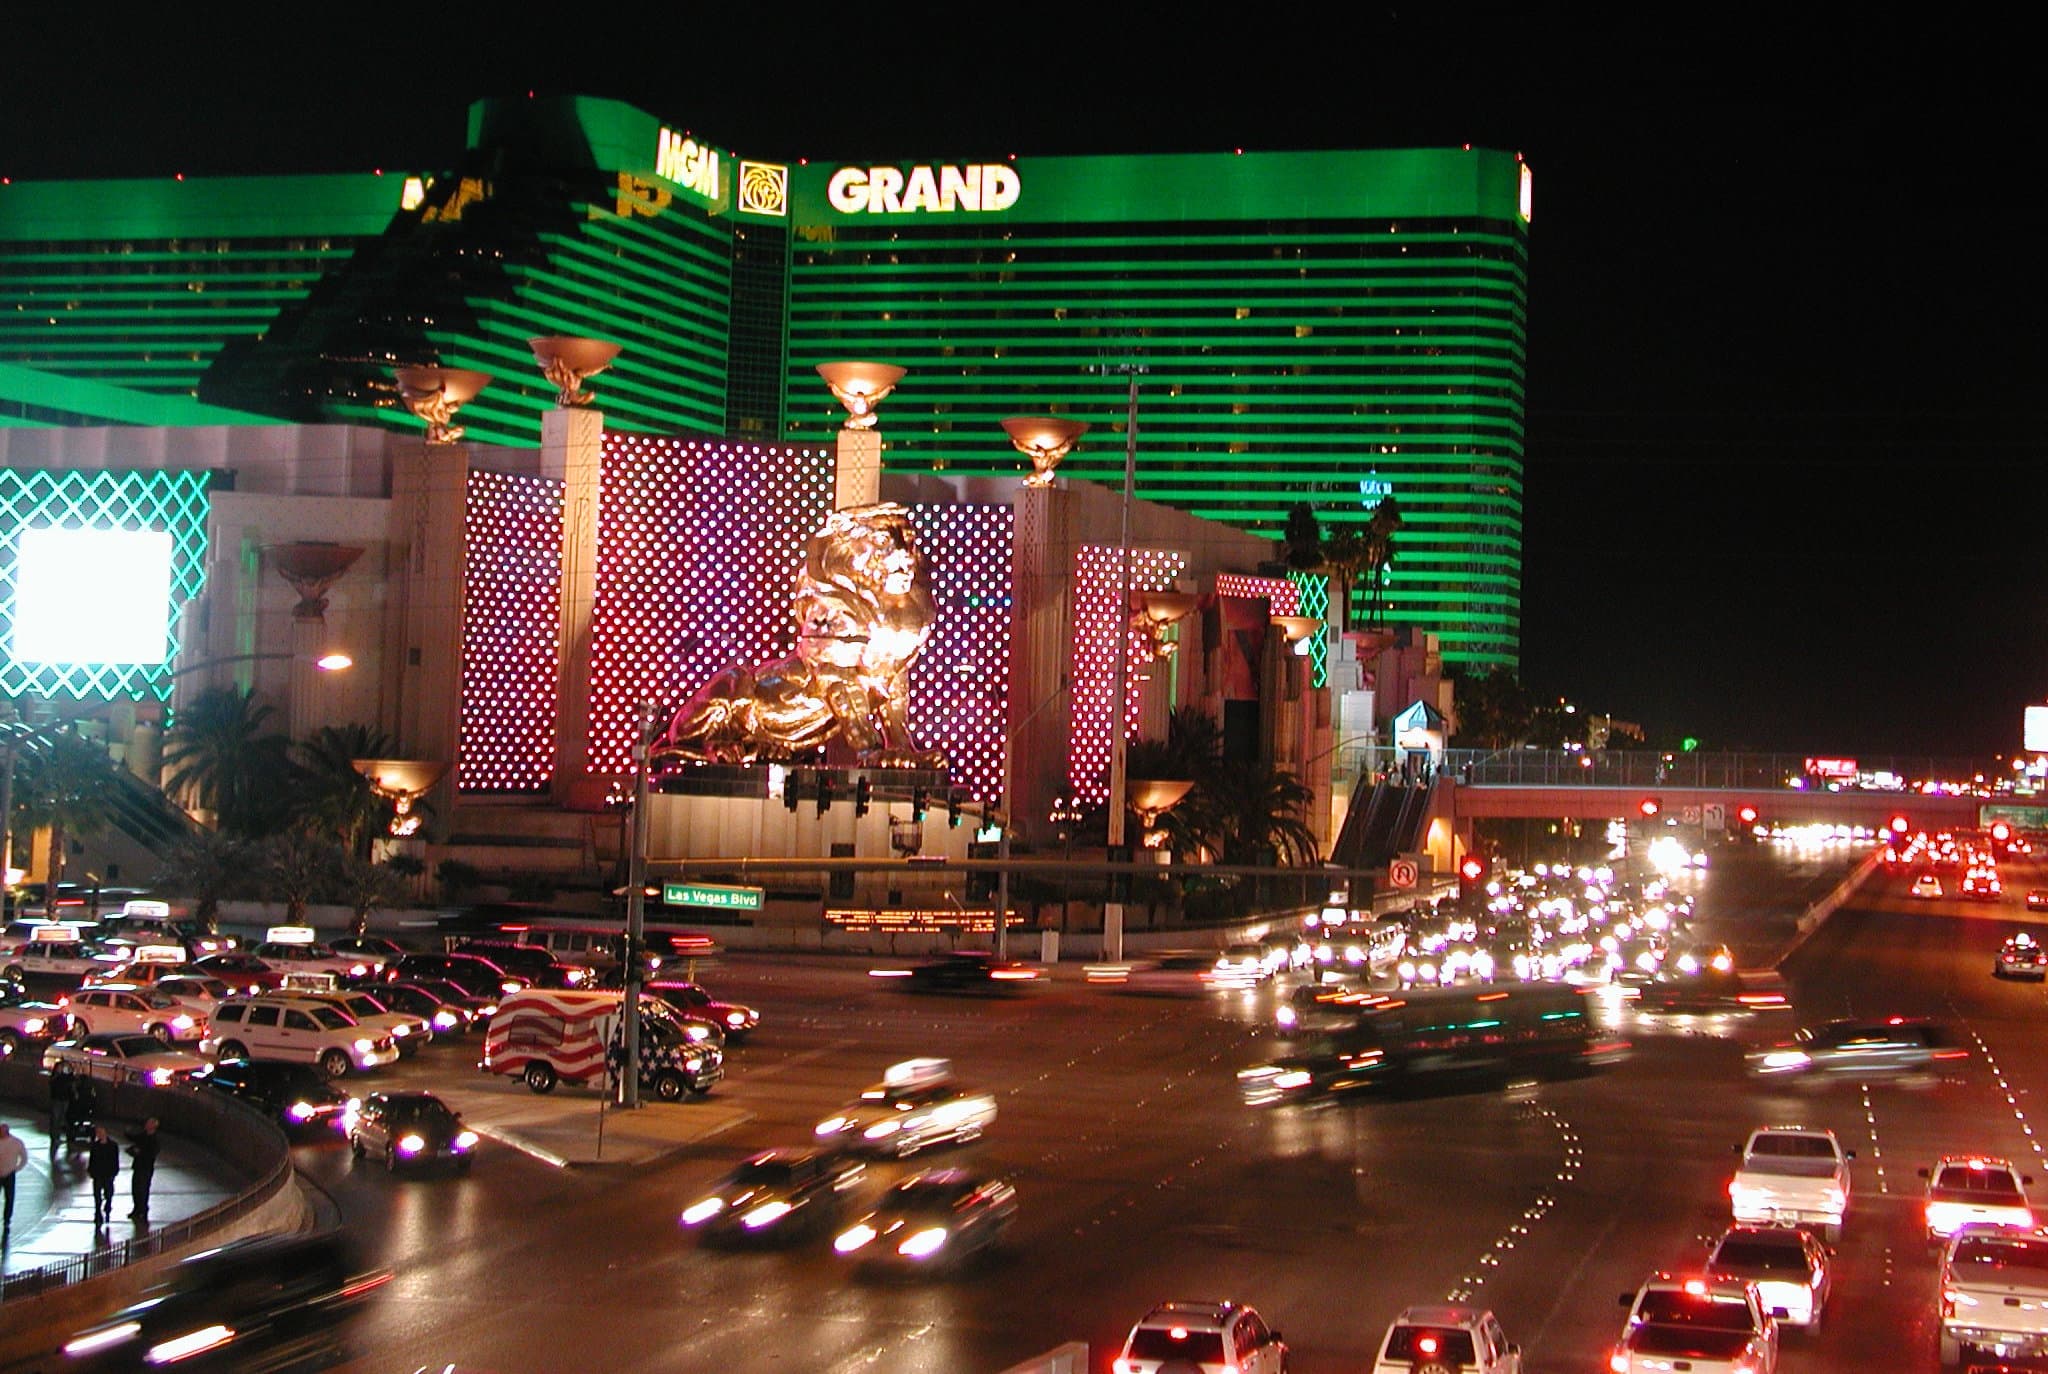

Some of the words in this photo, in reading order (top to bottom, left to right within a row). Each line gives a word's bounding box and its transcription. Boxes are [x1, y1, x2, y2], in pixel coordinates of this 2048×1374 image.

[656, 127, 718, 200] MGM
[828, 165, 1020, 213] GRAND
[667, 888, 690, 901] Las
[692, 890, 727, 906] Vegas
[730, 893, 757, 906] Blvd
